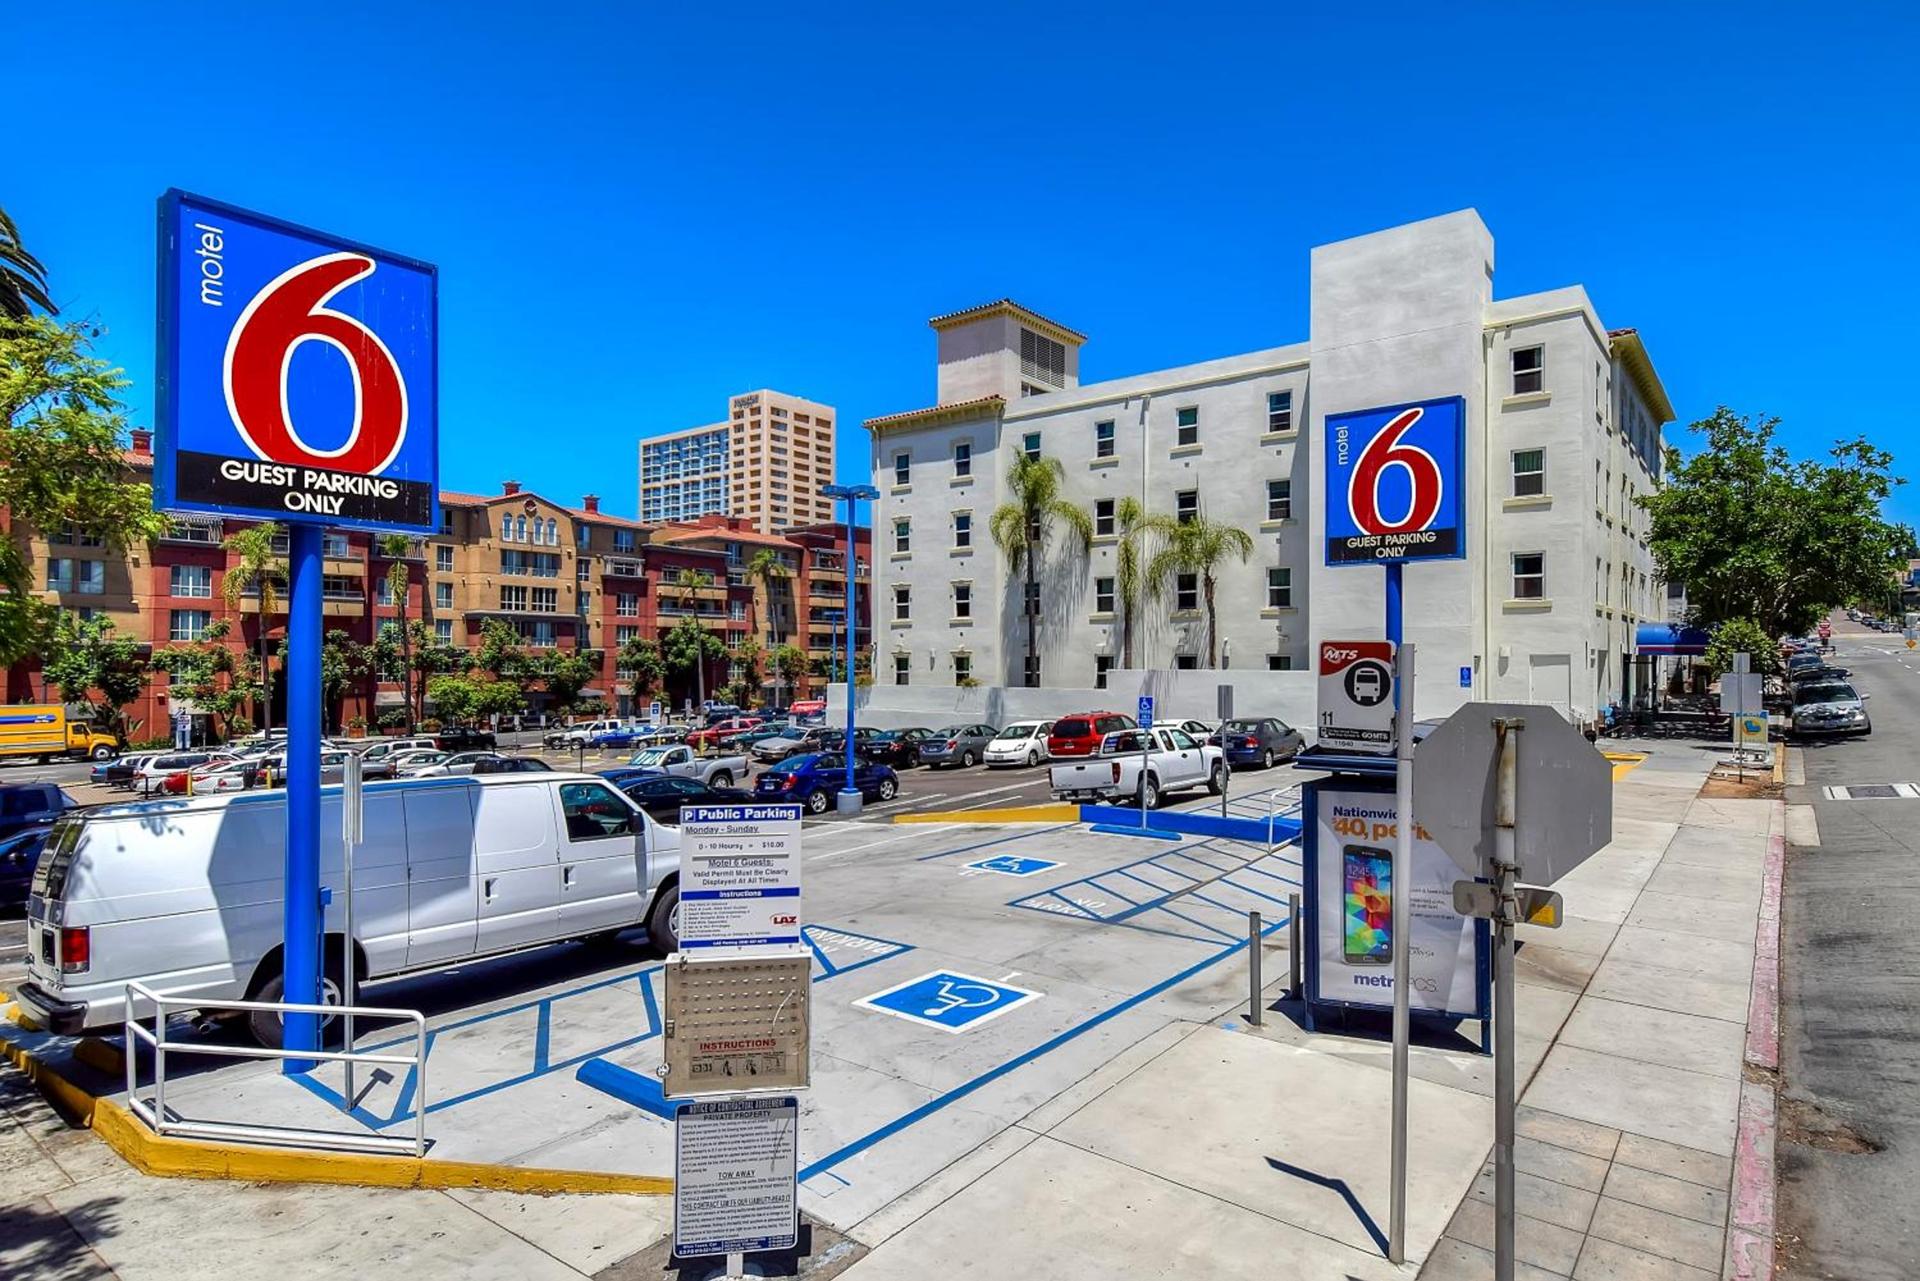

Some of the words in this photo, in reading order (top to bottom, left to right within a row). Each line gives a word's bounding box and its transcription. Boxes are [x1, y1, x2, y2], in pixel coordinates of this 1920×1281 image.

[195, 223, 224, 306] motel
[222, 251, 408, 475] 6
[1335, 426, 1349, 465] motel
[1348, 407, 1442, 535] 6
[220, 460, 296, 487] GUEST
[303, 470, 398, 499] PARKING
[284, 491, 344, 515] ONLY
[1347, 536, 1382, 549] GUEST
[1385, 532, 1437, 545] PARKING
[1376, 546, 1406, 558] ONLY
[1324, 648, 1358, 661] MTS
[1322, 711, 1333, 725] 11
[684, 810, 693, 820] P
[699, 809, 740, 820] Public
[744, 808, 795, 820] Parking
[686, 826, 719, 834] Monday
[727, 824, 759, 833] Sunday
[708, 859, 732, 867] Motel
[734, 858, 740, 866] 6
[765, 868, 788, 876] Clearly
[719, 890, 762, 898] Instructions
[773, 916, 797, 925] LAZ
[700, 1039, 776, 1050] INSTRUCTIONS
[709, 1102, 717, 1112] OF
[704, 1112, 732, 1120] PRIVATE
[735, 1110, 771, 1118] PROPERTY
[694, 1200, 719, 1208] CONTRACT
